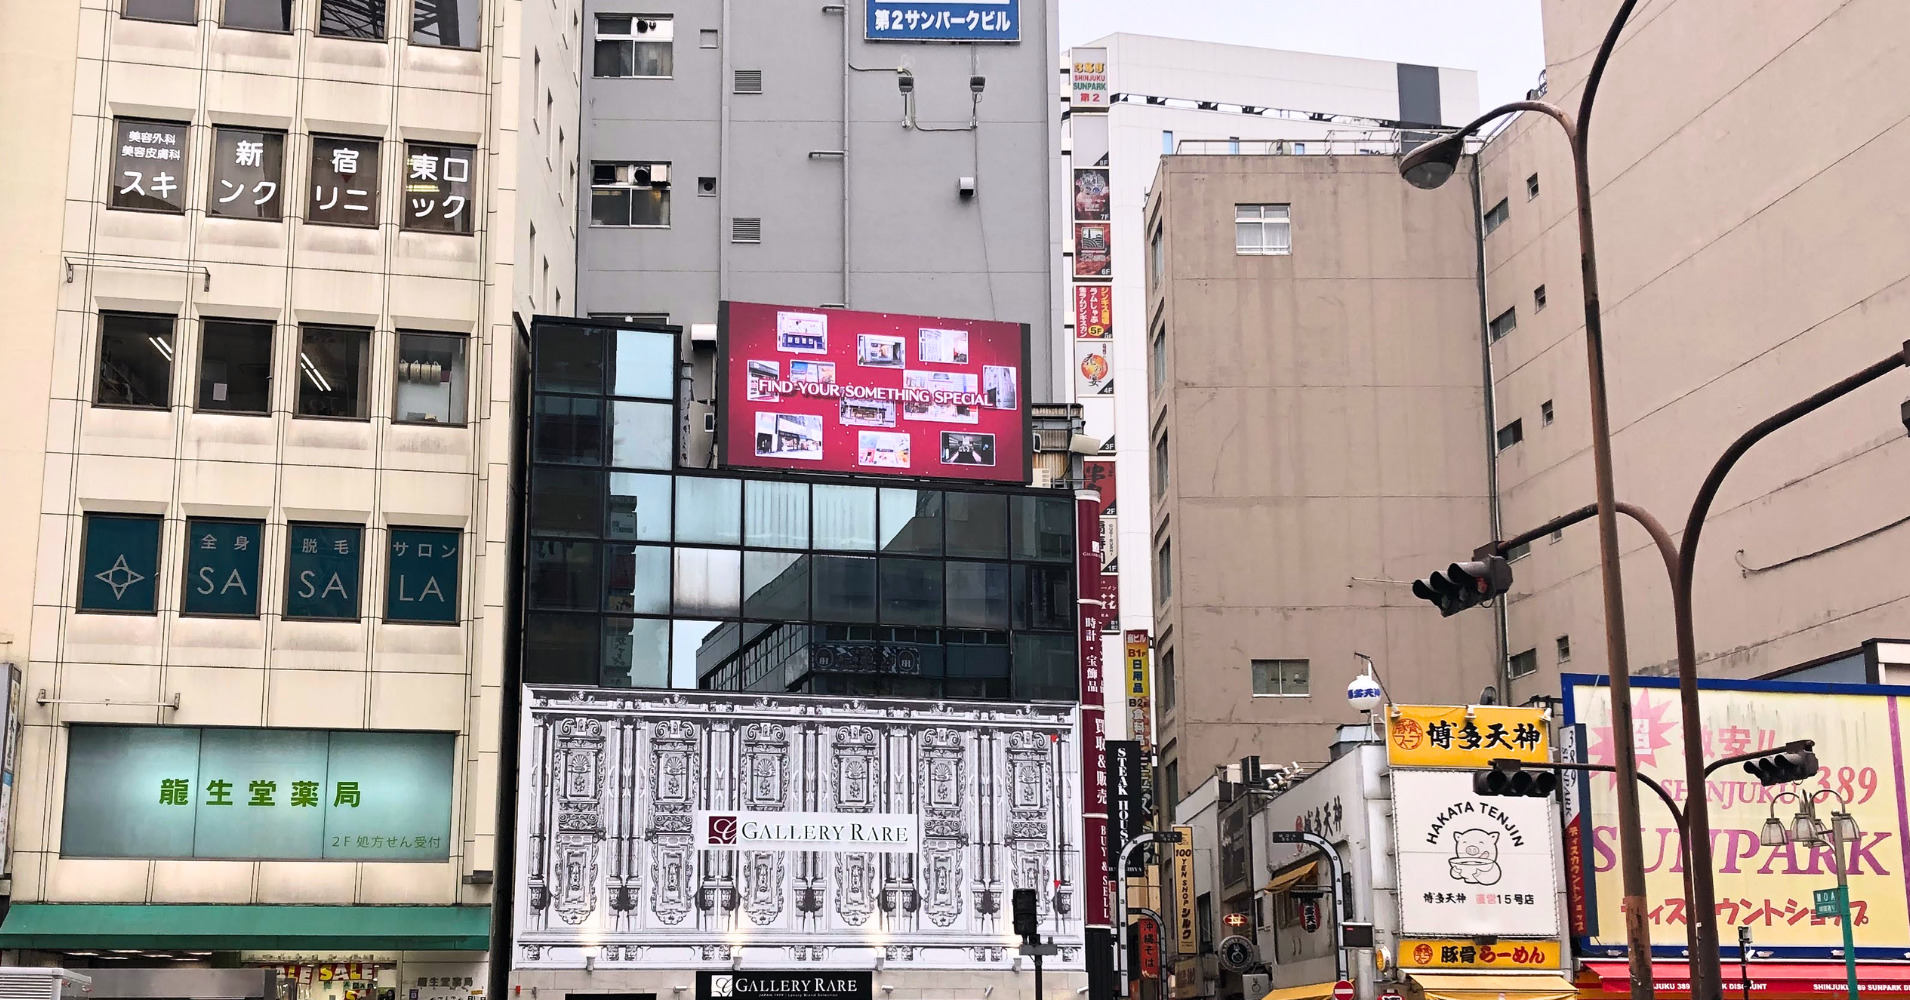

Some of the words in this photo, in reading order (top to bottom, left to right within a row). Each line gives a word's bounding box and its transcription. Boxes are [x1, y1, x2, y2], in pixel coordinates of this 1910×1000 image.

[875, 9, 1011, 32] 第2サンパークビル
[1073, 82, 1106, 90] SUNPARK
[129, 131, 176, 145] 美容外科
[121, 145, 181, 160] 美容皮膚科
[1090, 287, 1098, 323] ラムしゃぶ
[757, 379, 793, 394] FIND
[798, 381, 840, 397] YOUR
[844, 385, 930, 403] SOMETHING
[934, 390, 994, 406] SPECIAL
[1085, 617, 1098, 693] 時計・宝飾品
[1128, 648, 1146, 658] B1F
[1132, 659, 1143, 693] 日用品
[1128, 698, 1147, 708] B2F
[1426, 719, 1542, 752] 博多天神
[1095, 718, 1107, 805] 買取&販売
[1117, 748, 1128, 795] STEAK
[158, 778, 361, 808] 龍生堂薬局
[1659, 778, 1797, 810] SHNJUKU
[1813, 766, 1878, 805] 389
[742, 821, 845, 841] GALLERY
[850, 823, 909, 842] RARE
[1426, 801, 1474, 844] HAKATA
[1479, 802, 1525, 847] TENJIN
[1175, 849, 1191, 858] 100
[1101, 862, 1108, 872] &
[1180, 858, 1188, 878] YEN
[1181, 881, 1189, 907] SHOP
[1423, 891, 1467, 904] 博多天神
[1816, 891, 1836, 902] MOA
[1181, 907, 1191, 940] シルク
[276, 964, 311, 985] ALE
[319, 963, 374, 981] SALE
[735, 977, 811, 993] GALLERY
[814, 977, 858, 992] RARE
[1653, 982, 1675, 990] JUKU
[1677, 982, 1691, 990] 389
